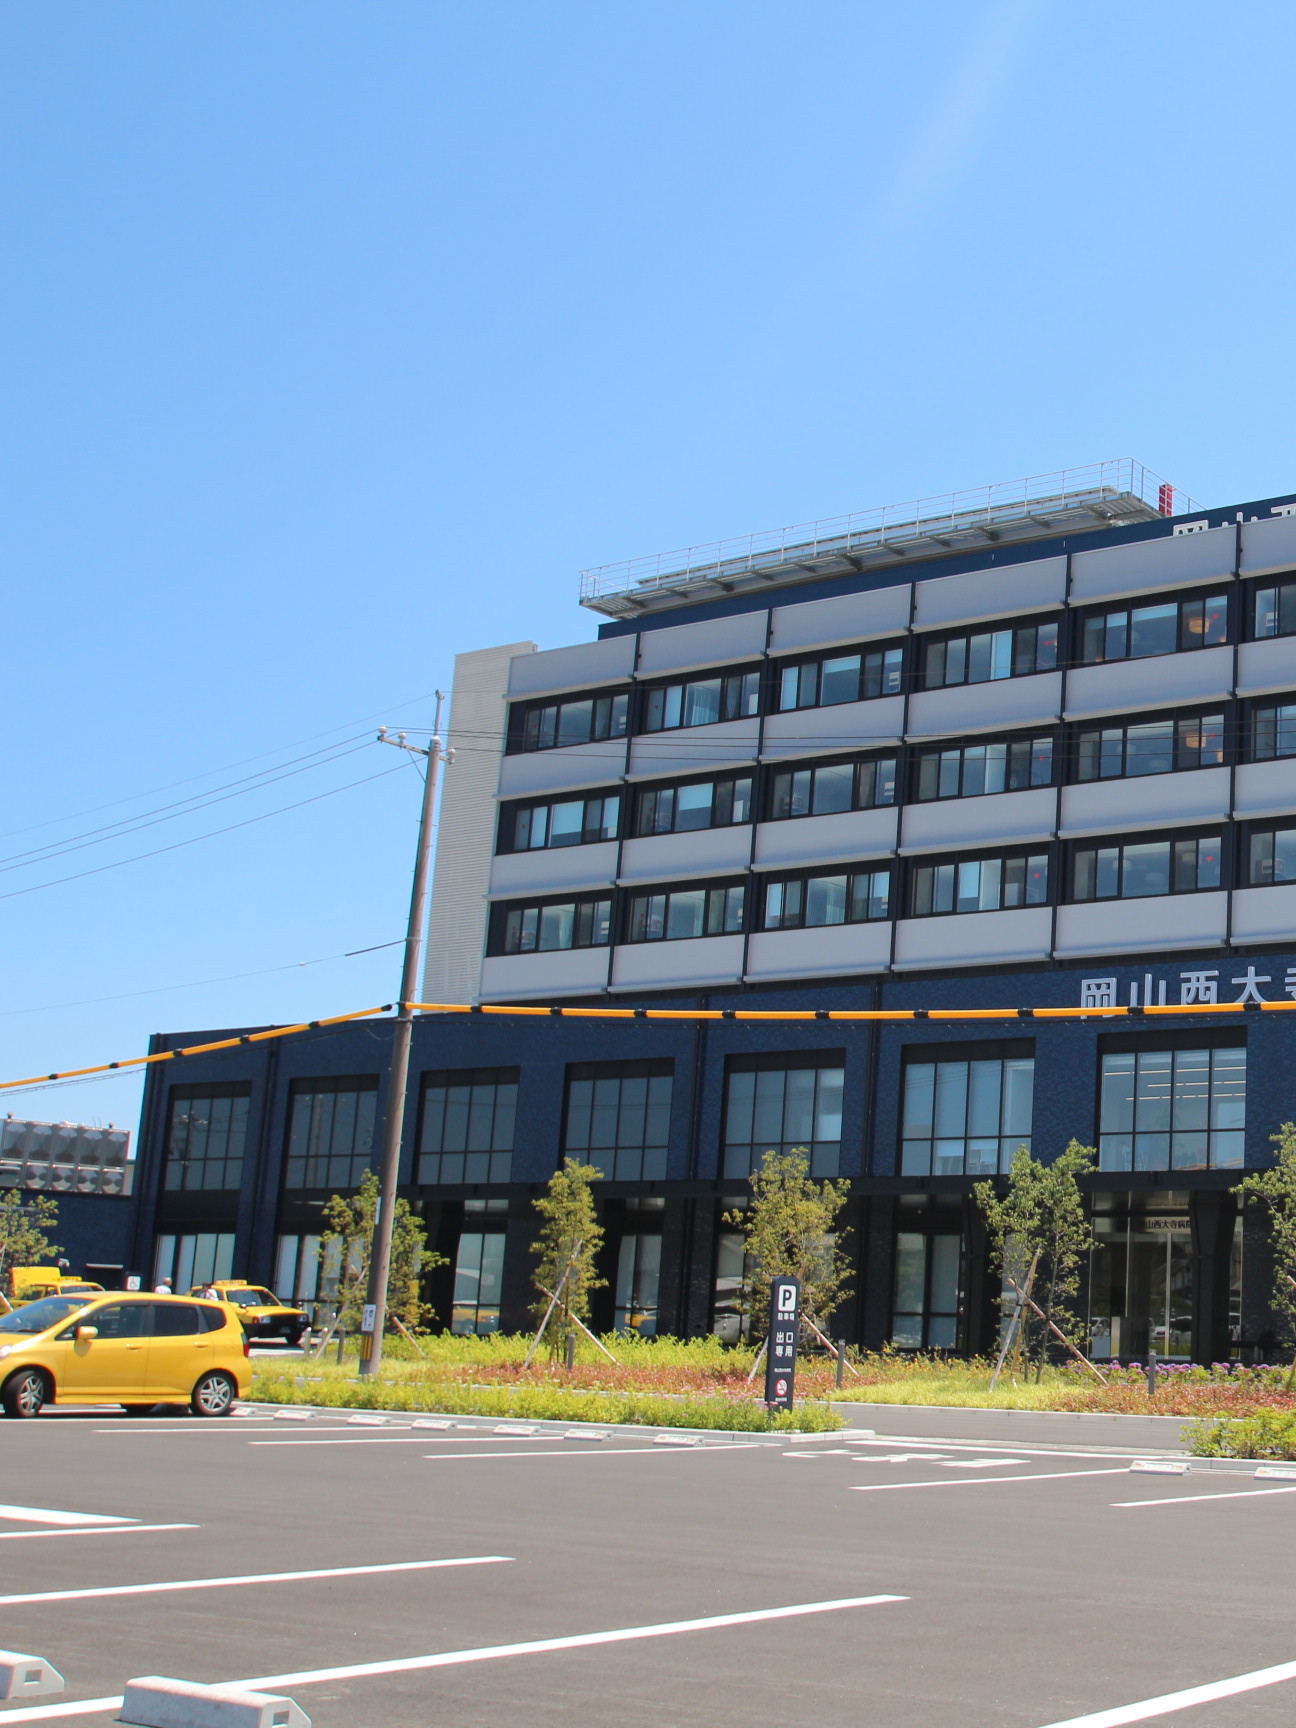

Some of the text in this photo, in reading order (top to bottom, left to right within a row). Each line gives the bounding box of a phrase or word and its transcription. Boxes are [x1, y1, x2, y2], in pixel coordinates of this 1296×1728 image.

[1145, 1219, 1191, 1229] 山西大寺病
[782, 1289, 792, 1307] P
[776, 1331, 794, 1344] 出口
[775, 1345, 793, 1357] 専用
